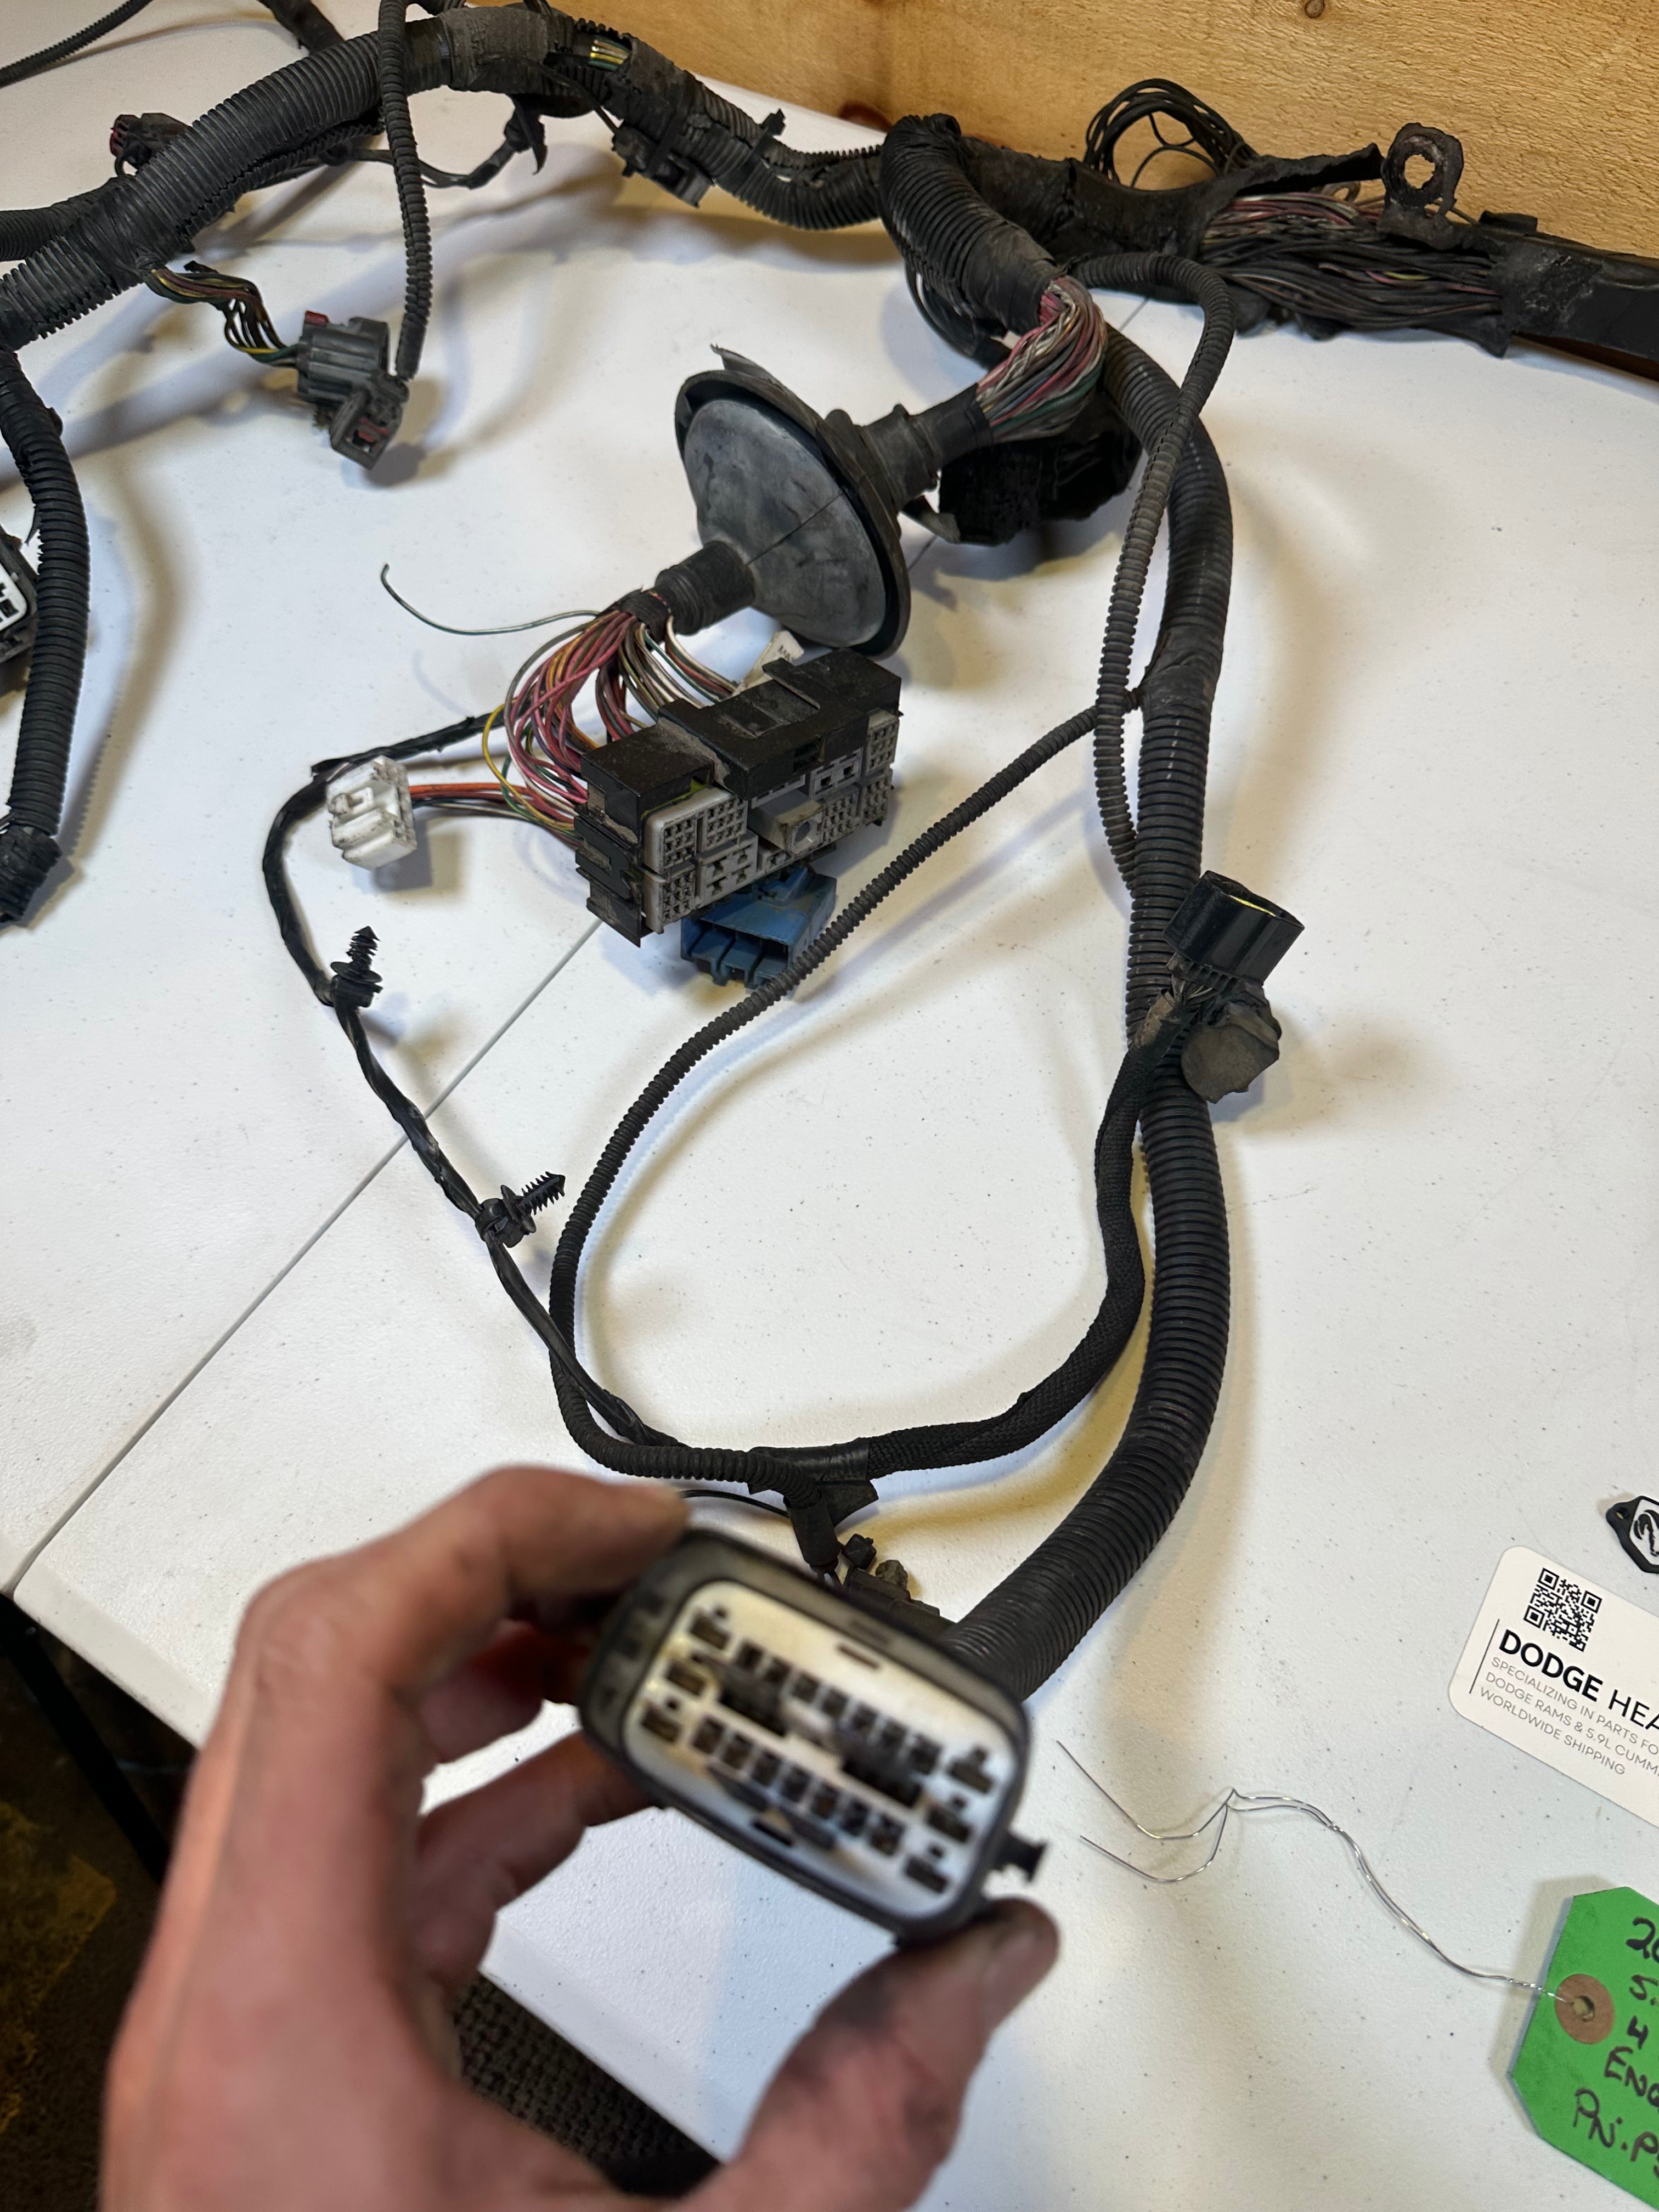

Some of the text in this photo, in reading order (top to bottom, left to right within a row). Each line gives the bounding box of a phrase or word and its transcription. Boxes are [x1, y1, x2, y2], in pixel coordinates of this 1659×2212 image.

[1492, 1657, 1659, 1759] SPECIALIZING IN PARTS FO
[1499, 1629, 1603, 1702] DODGE
[1480, 1687, 1625, 1774] WORLDWIDE SHIPPING
[1486, 1672, 1659, 1776] DODGE RAMS & 5.9L CUMM
